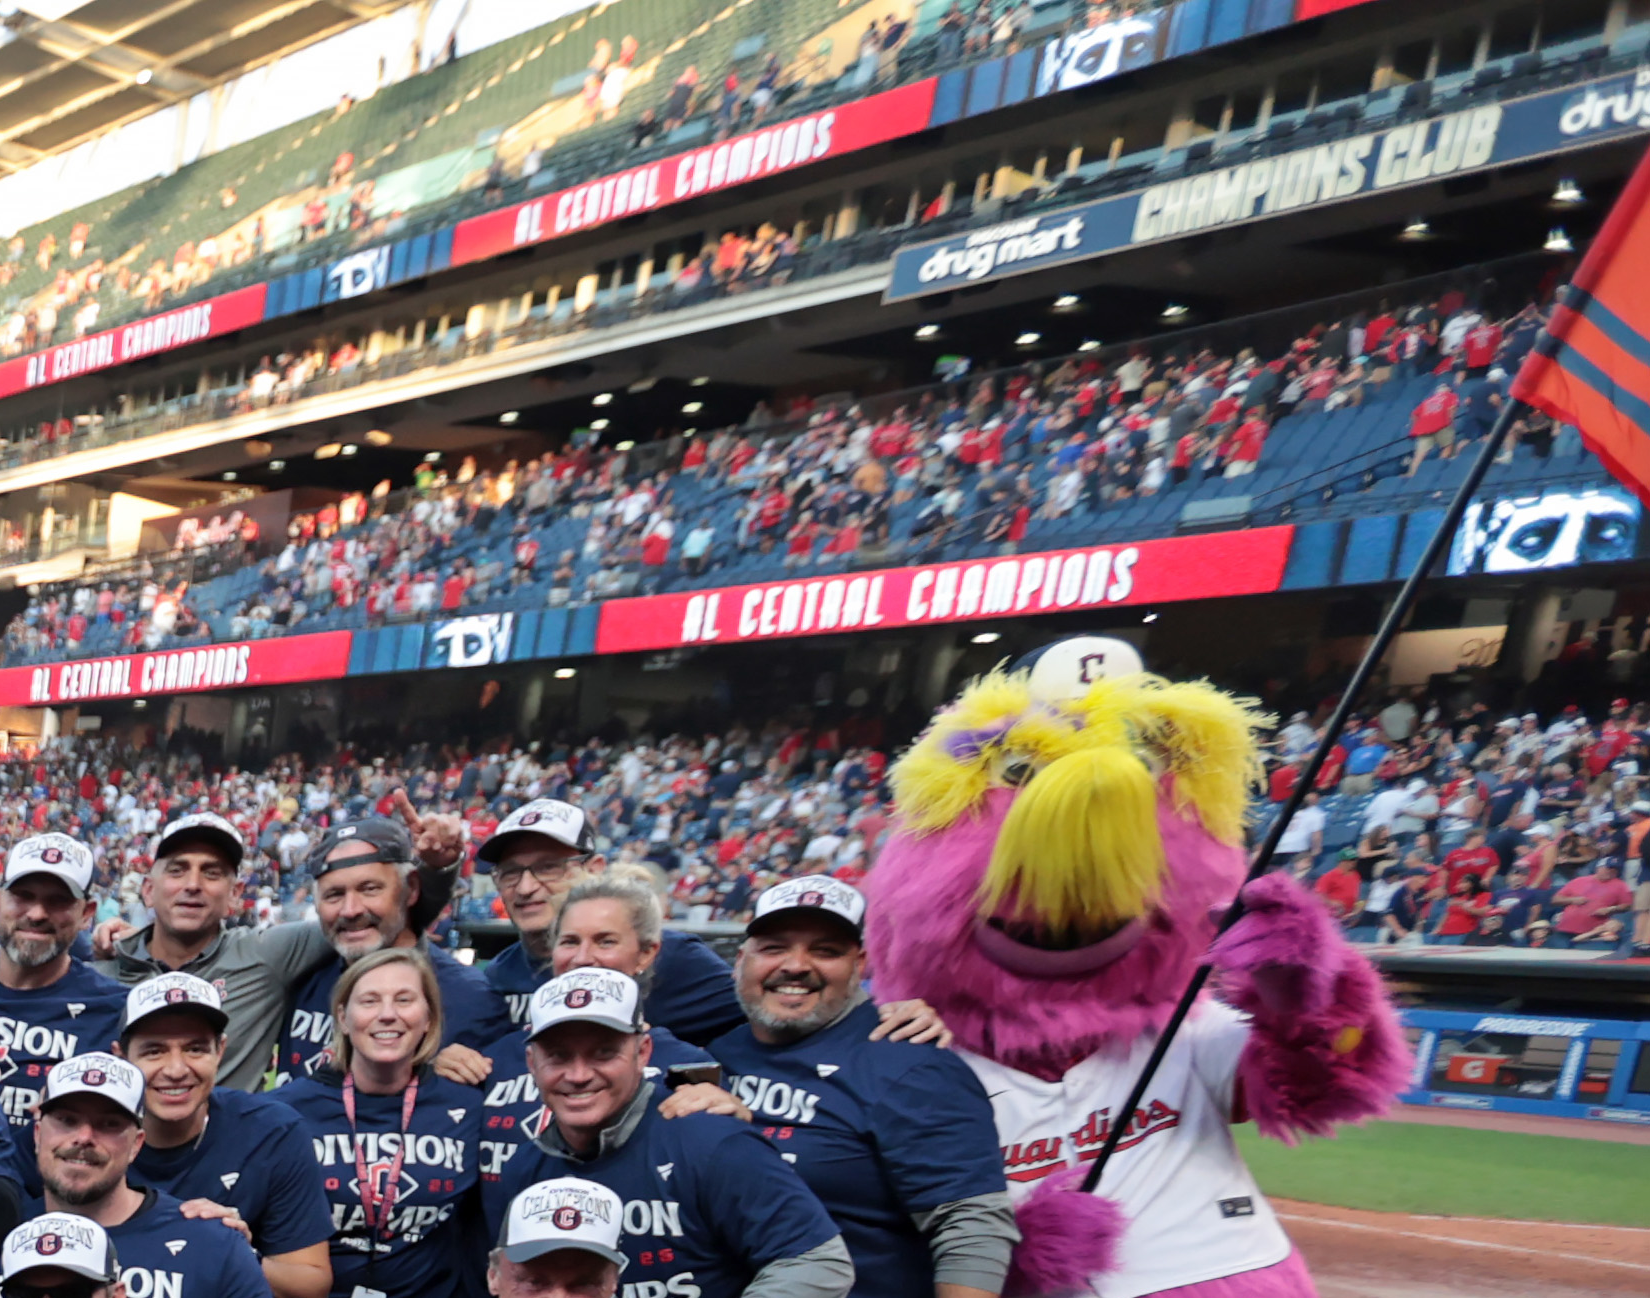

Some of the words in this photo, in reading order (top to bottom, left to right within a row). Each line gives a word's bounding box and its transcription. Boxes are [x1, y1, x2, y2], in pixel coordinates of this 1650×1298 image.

[514, 201, 544, 245] AL
[555, 166, 661, 233] CENTRAL
[674, 112, 836, 198] CHAMPIONS
[1131, 134, 1376, 244] CHAMPIONS
[1373, 106, 1503, 189] CLUB
[918, 238, 1000, 283] drug
[1001, 215, 1085, 264] mart
[681, 593, 721, 643] AL
[739, 575, 885, 637] CENTRAL
[906, 547, 1140, 622] CHAMPIONS
[1079, 653, 1106, 683] C
[539, 980, 624, 1009] CHAMPIONS
[1461, 1060, 1485, 1079] G
[1001, 1099, 1181, 1167] uardins
[522, 1193, 613, 1221] CHAMPIONS
[12, 1223, 94, 1253] CHAMPIONS
